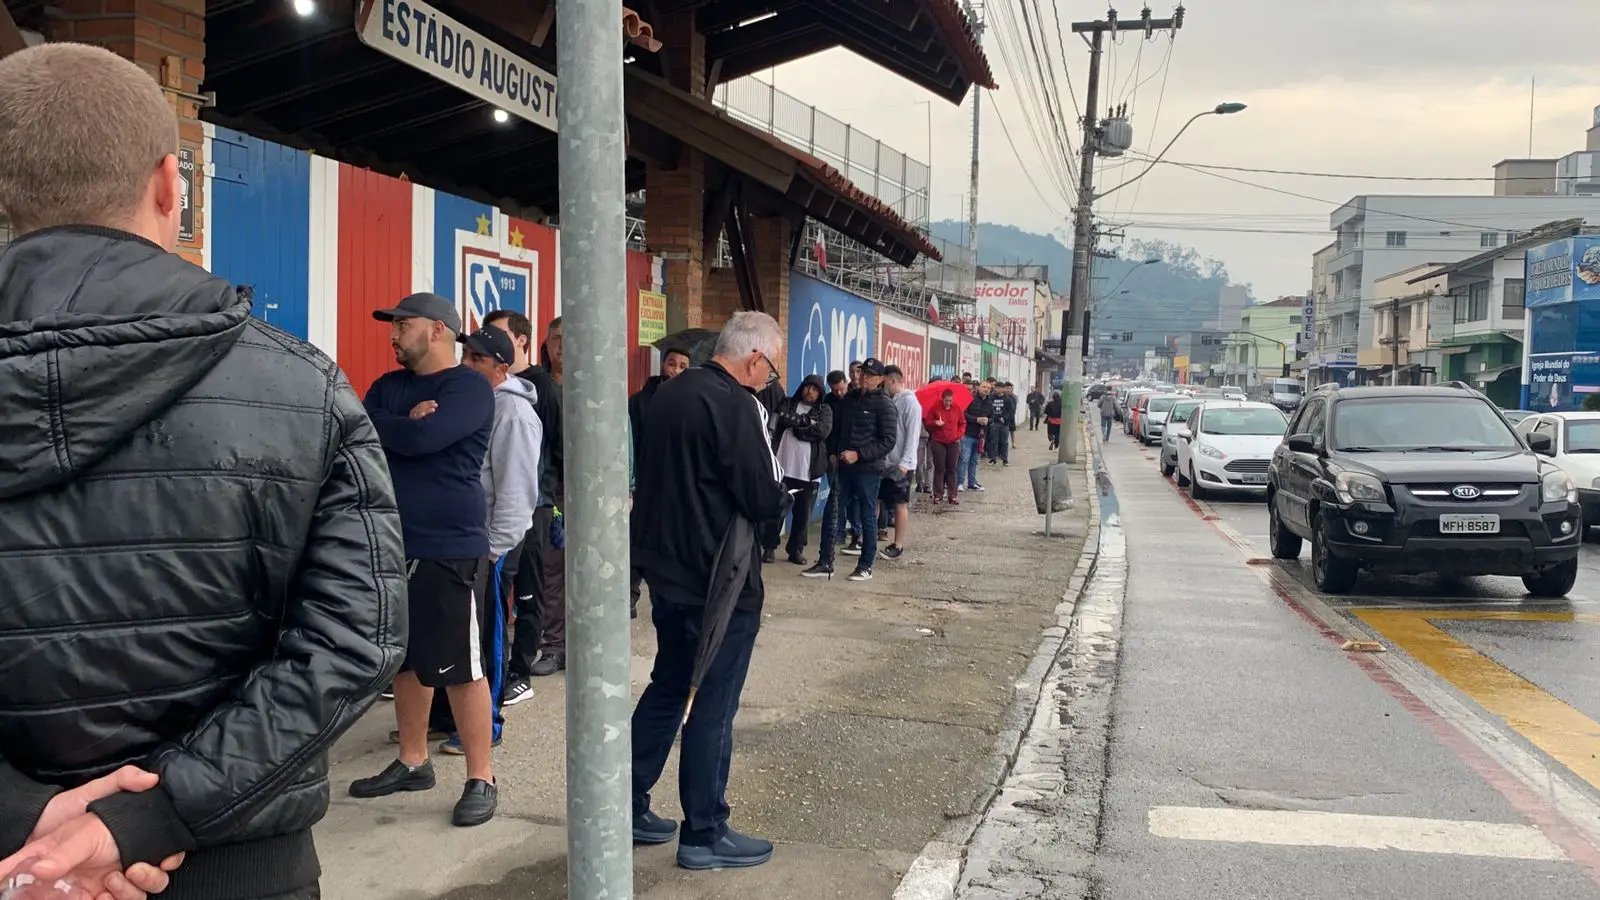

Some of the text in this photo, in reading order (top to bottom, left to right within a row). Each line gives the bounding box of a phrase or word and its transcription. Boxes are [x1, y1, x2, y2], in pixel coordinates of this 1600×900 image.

[479, 47, 558, 120] AUGUST
[500, 277, 516, 291] 1913
[1305, 298, 1314, 340] HOTEL
[1531, 361, 1544, 371] Igreja
[1544, 359, 1563, 369] Mundial
[1563, 360, 1570, 368] do
[1533, 373, 1567, 383] Poder de Deus
[1457, 488, 1476, 496] KIA
